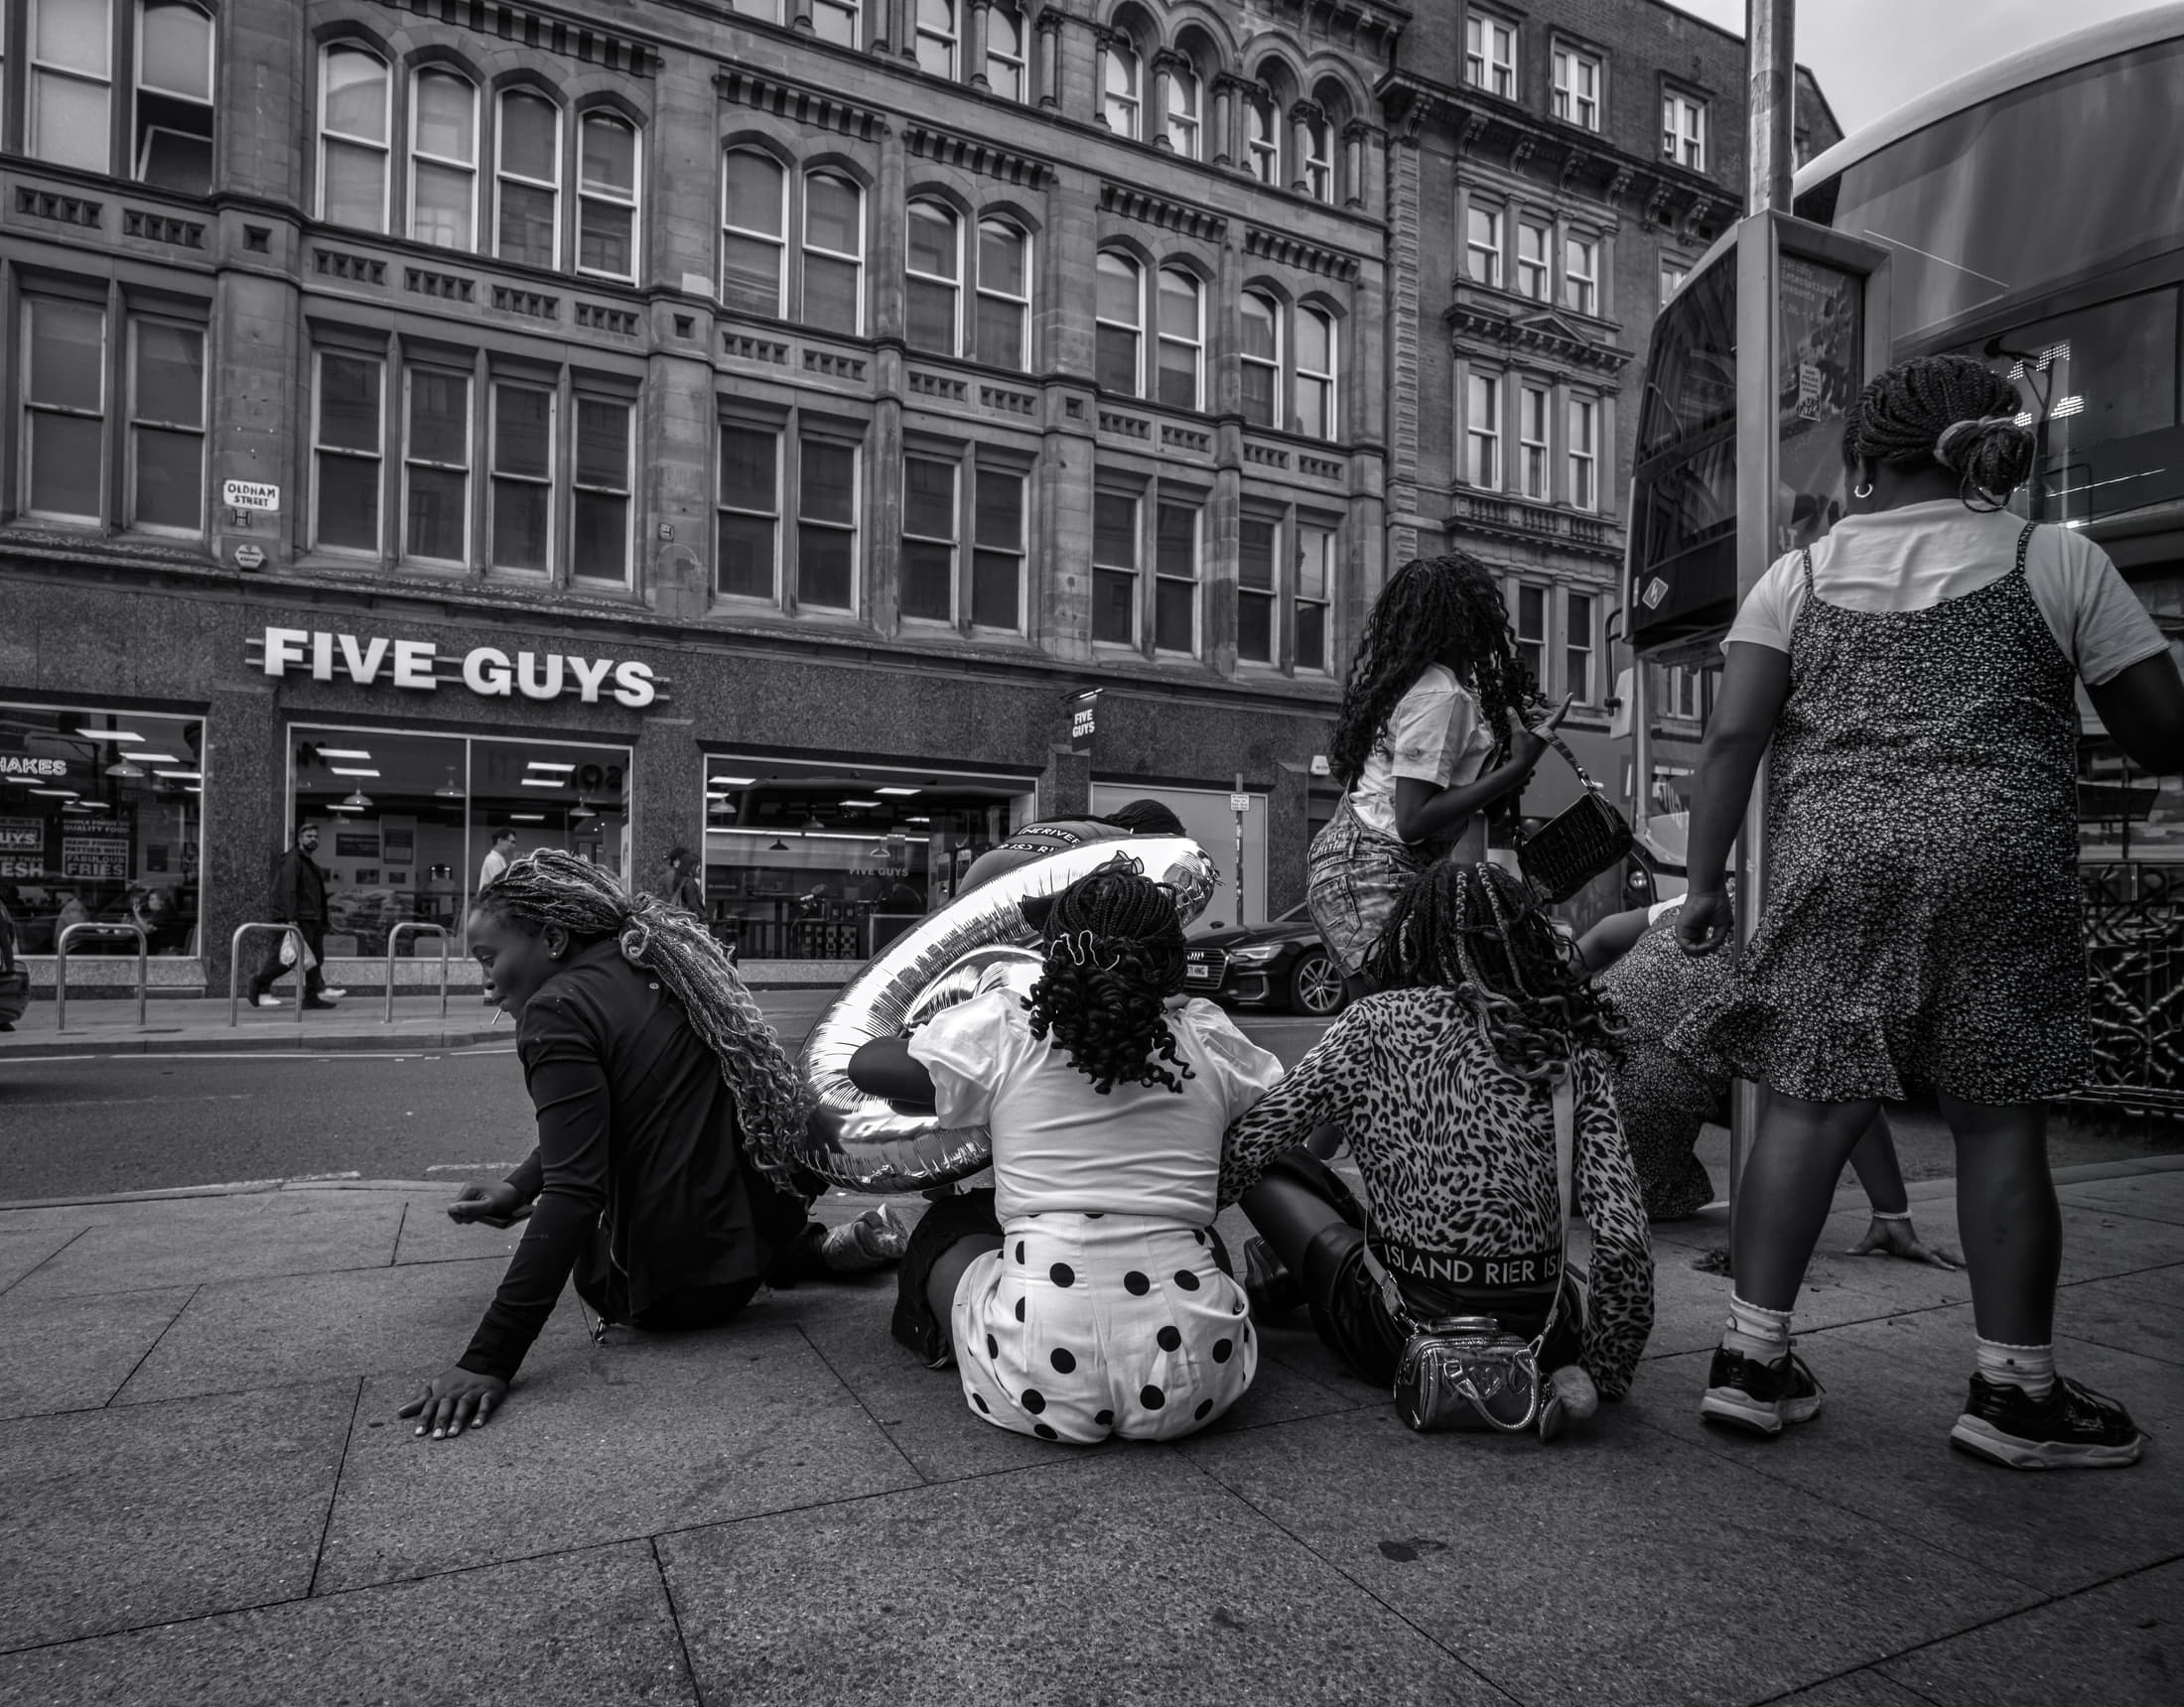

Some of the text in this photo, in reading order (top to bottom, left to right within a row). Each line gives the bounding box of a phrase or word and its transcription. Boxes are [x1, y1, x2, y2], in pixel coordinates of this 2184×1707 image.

[227, 483, 276, 498] OLDHAM
[233, 495, 269, 507] STREET
[264, 626, 655, 708] FIVE GUYS
[1074, 709, 1093, 725] FIVE
[1072, 721, 1095, 737] GUYS
[67, 854, 125, 863] FABULOUS
[67, 862, 125, 875] FRIES
[878, 867, 909, 877] GUYS
[1384, 1243, 1473, 1283] ISLAND
